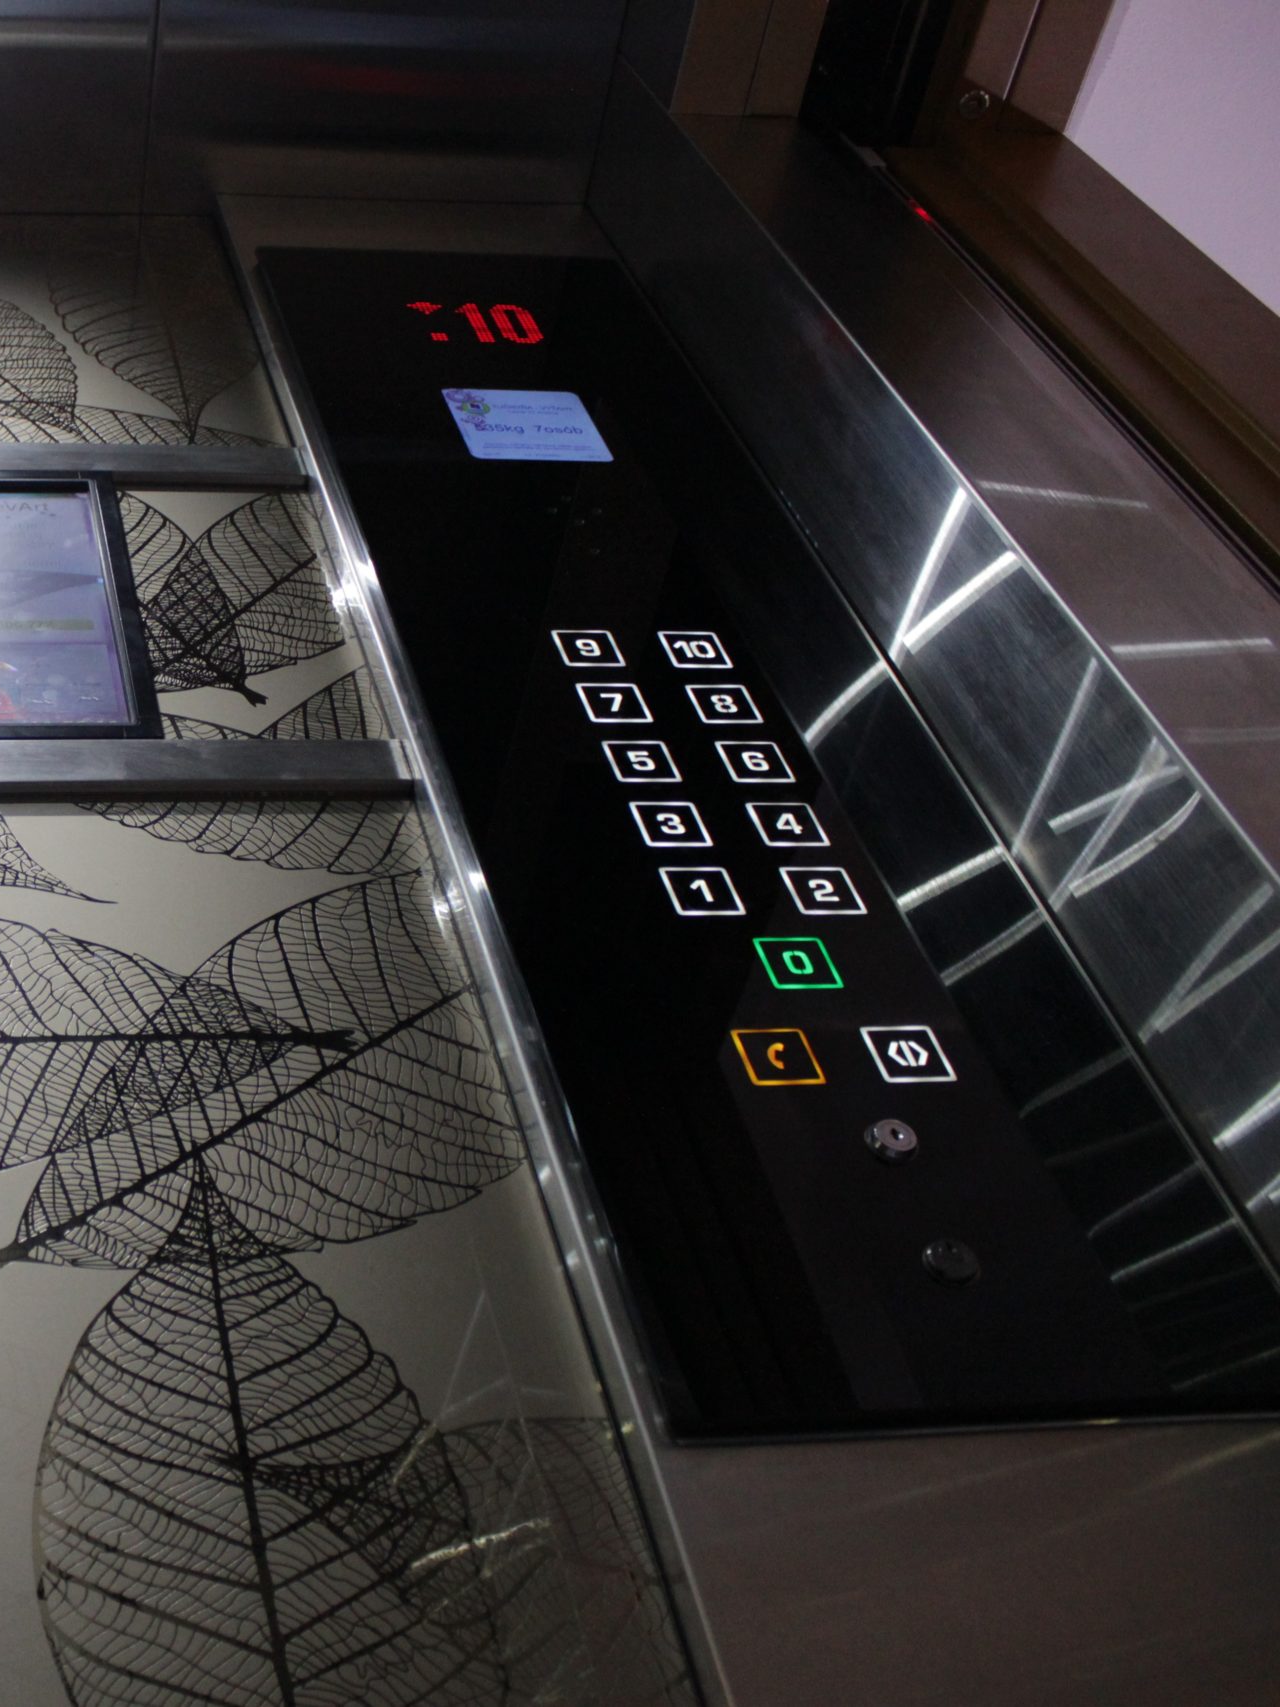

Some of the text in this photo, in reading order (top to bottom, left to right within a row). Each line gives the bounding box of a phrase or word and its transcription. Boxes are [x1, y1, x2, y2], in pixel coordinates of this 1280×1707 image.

[456, 304, 544, 343] 10
[574, 638, 601, 657] 9
[673, 640, 716, 659] 10
[600, 693, 622, 712] 7
[711, 695, 738, 713] 8
[627, 751, 655, 770] 5
[741, 751, 770, 771] 6
[657, 813, 686, 834] 3
[776, 813, 803, 834] 4
[690, 880, 713, 902] 1
[808, 879, 839, 901] 2
[783, 951, 813, 974] 0
